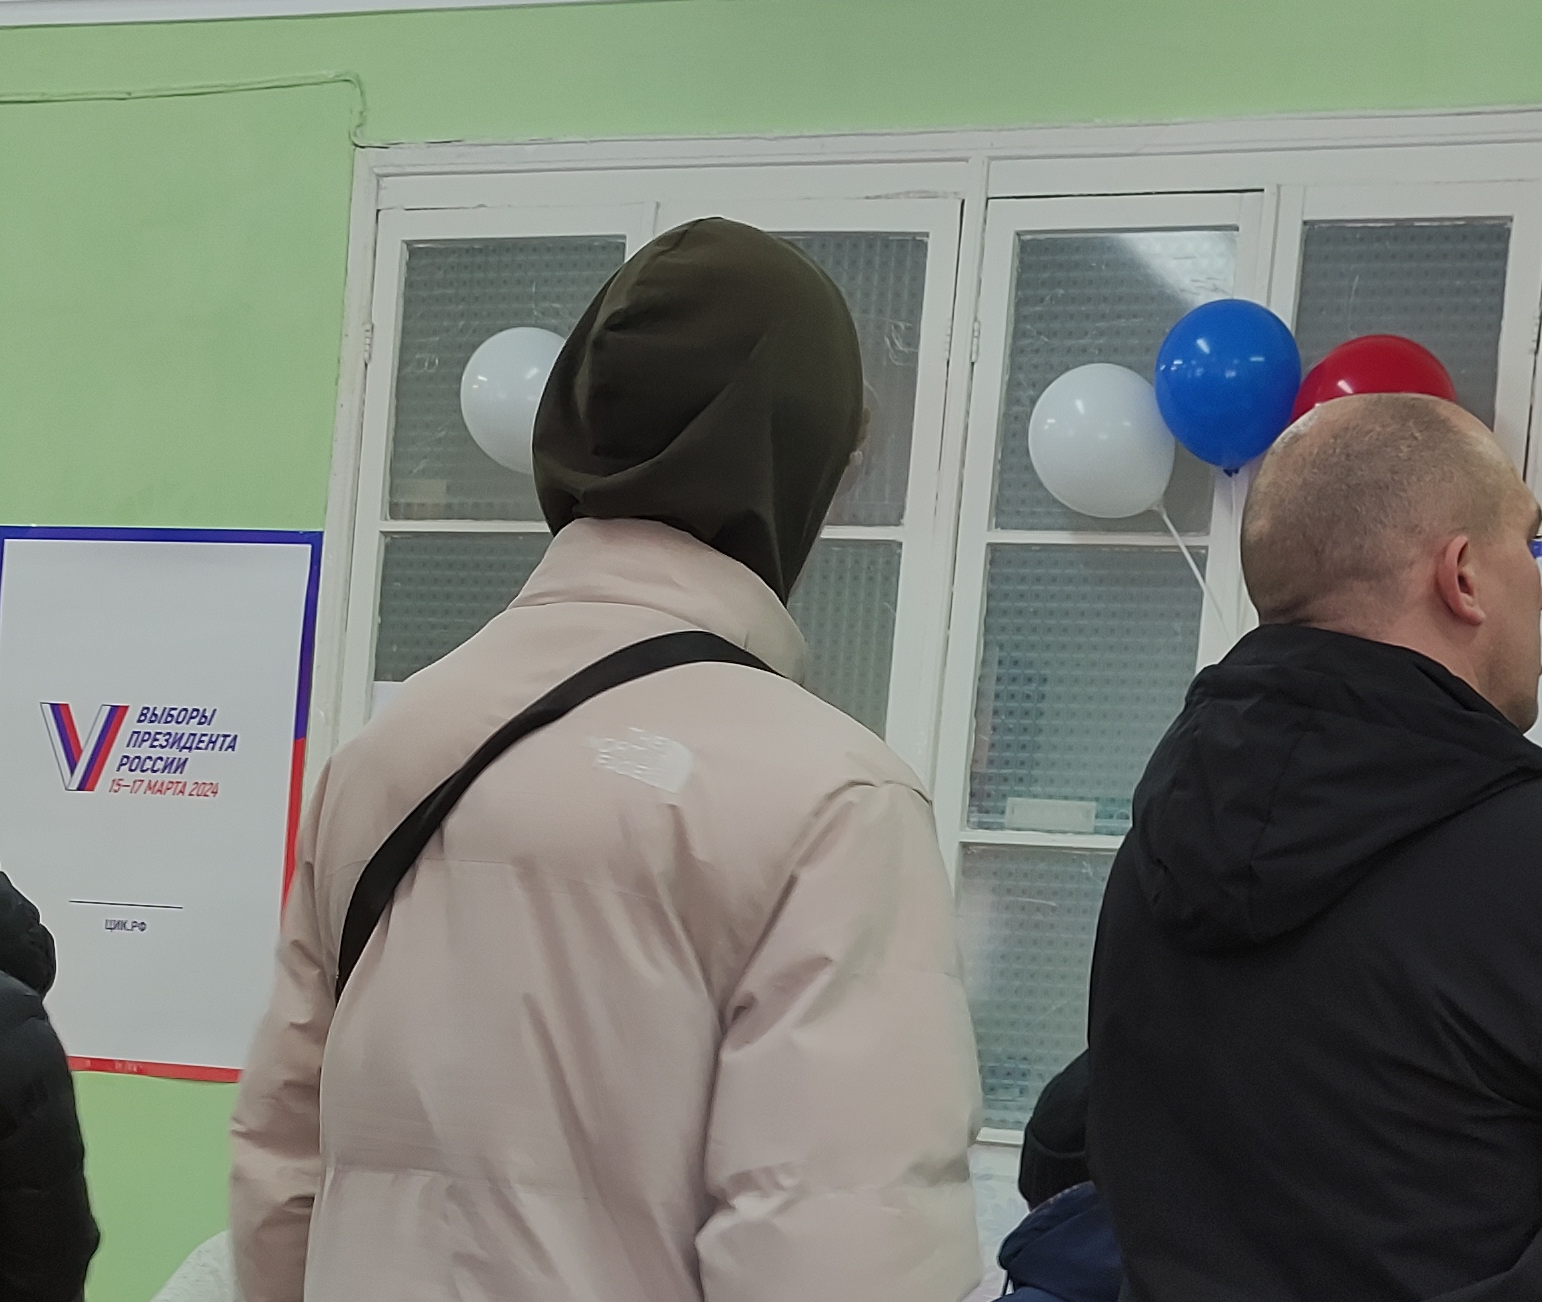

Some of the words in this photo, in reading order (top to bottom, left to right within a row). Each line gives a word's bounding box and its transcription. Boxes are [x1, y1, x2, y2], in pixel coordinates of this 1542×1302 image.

[136, 706, 217, 726] ВЫБОРЫ
[125, 730, 238, 753] ПРЕЗИДЕНТА
[116, 755, 189, 775] РОССИИ
[143, 780, 187, 797] МАРТА
[187, 781, 219, 798] 2024
[105, 919, 147, 932] ЦИК.РФ
